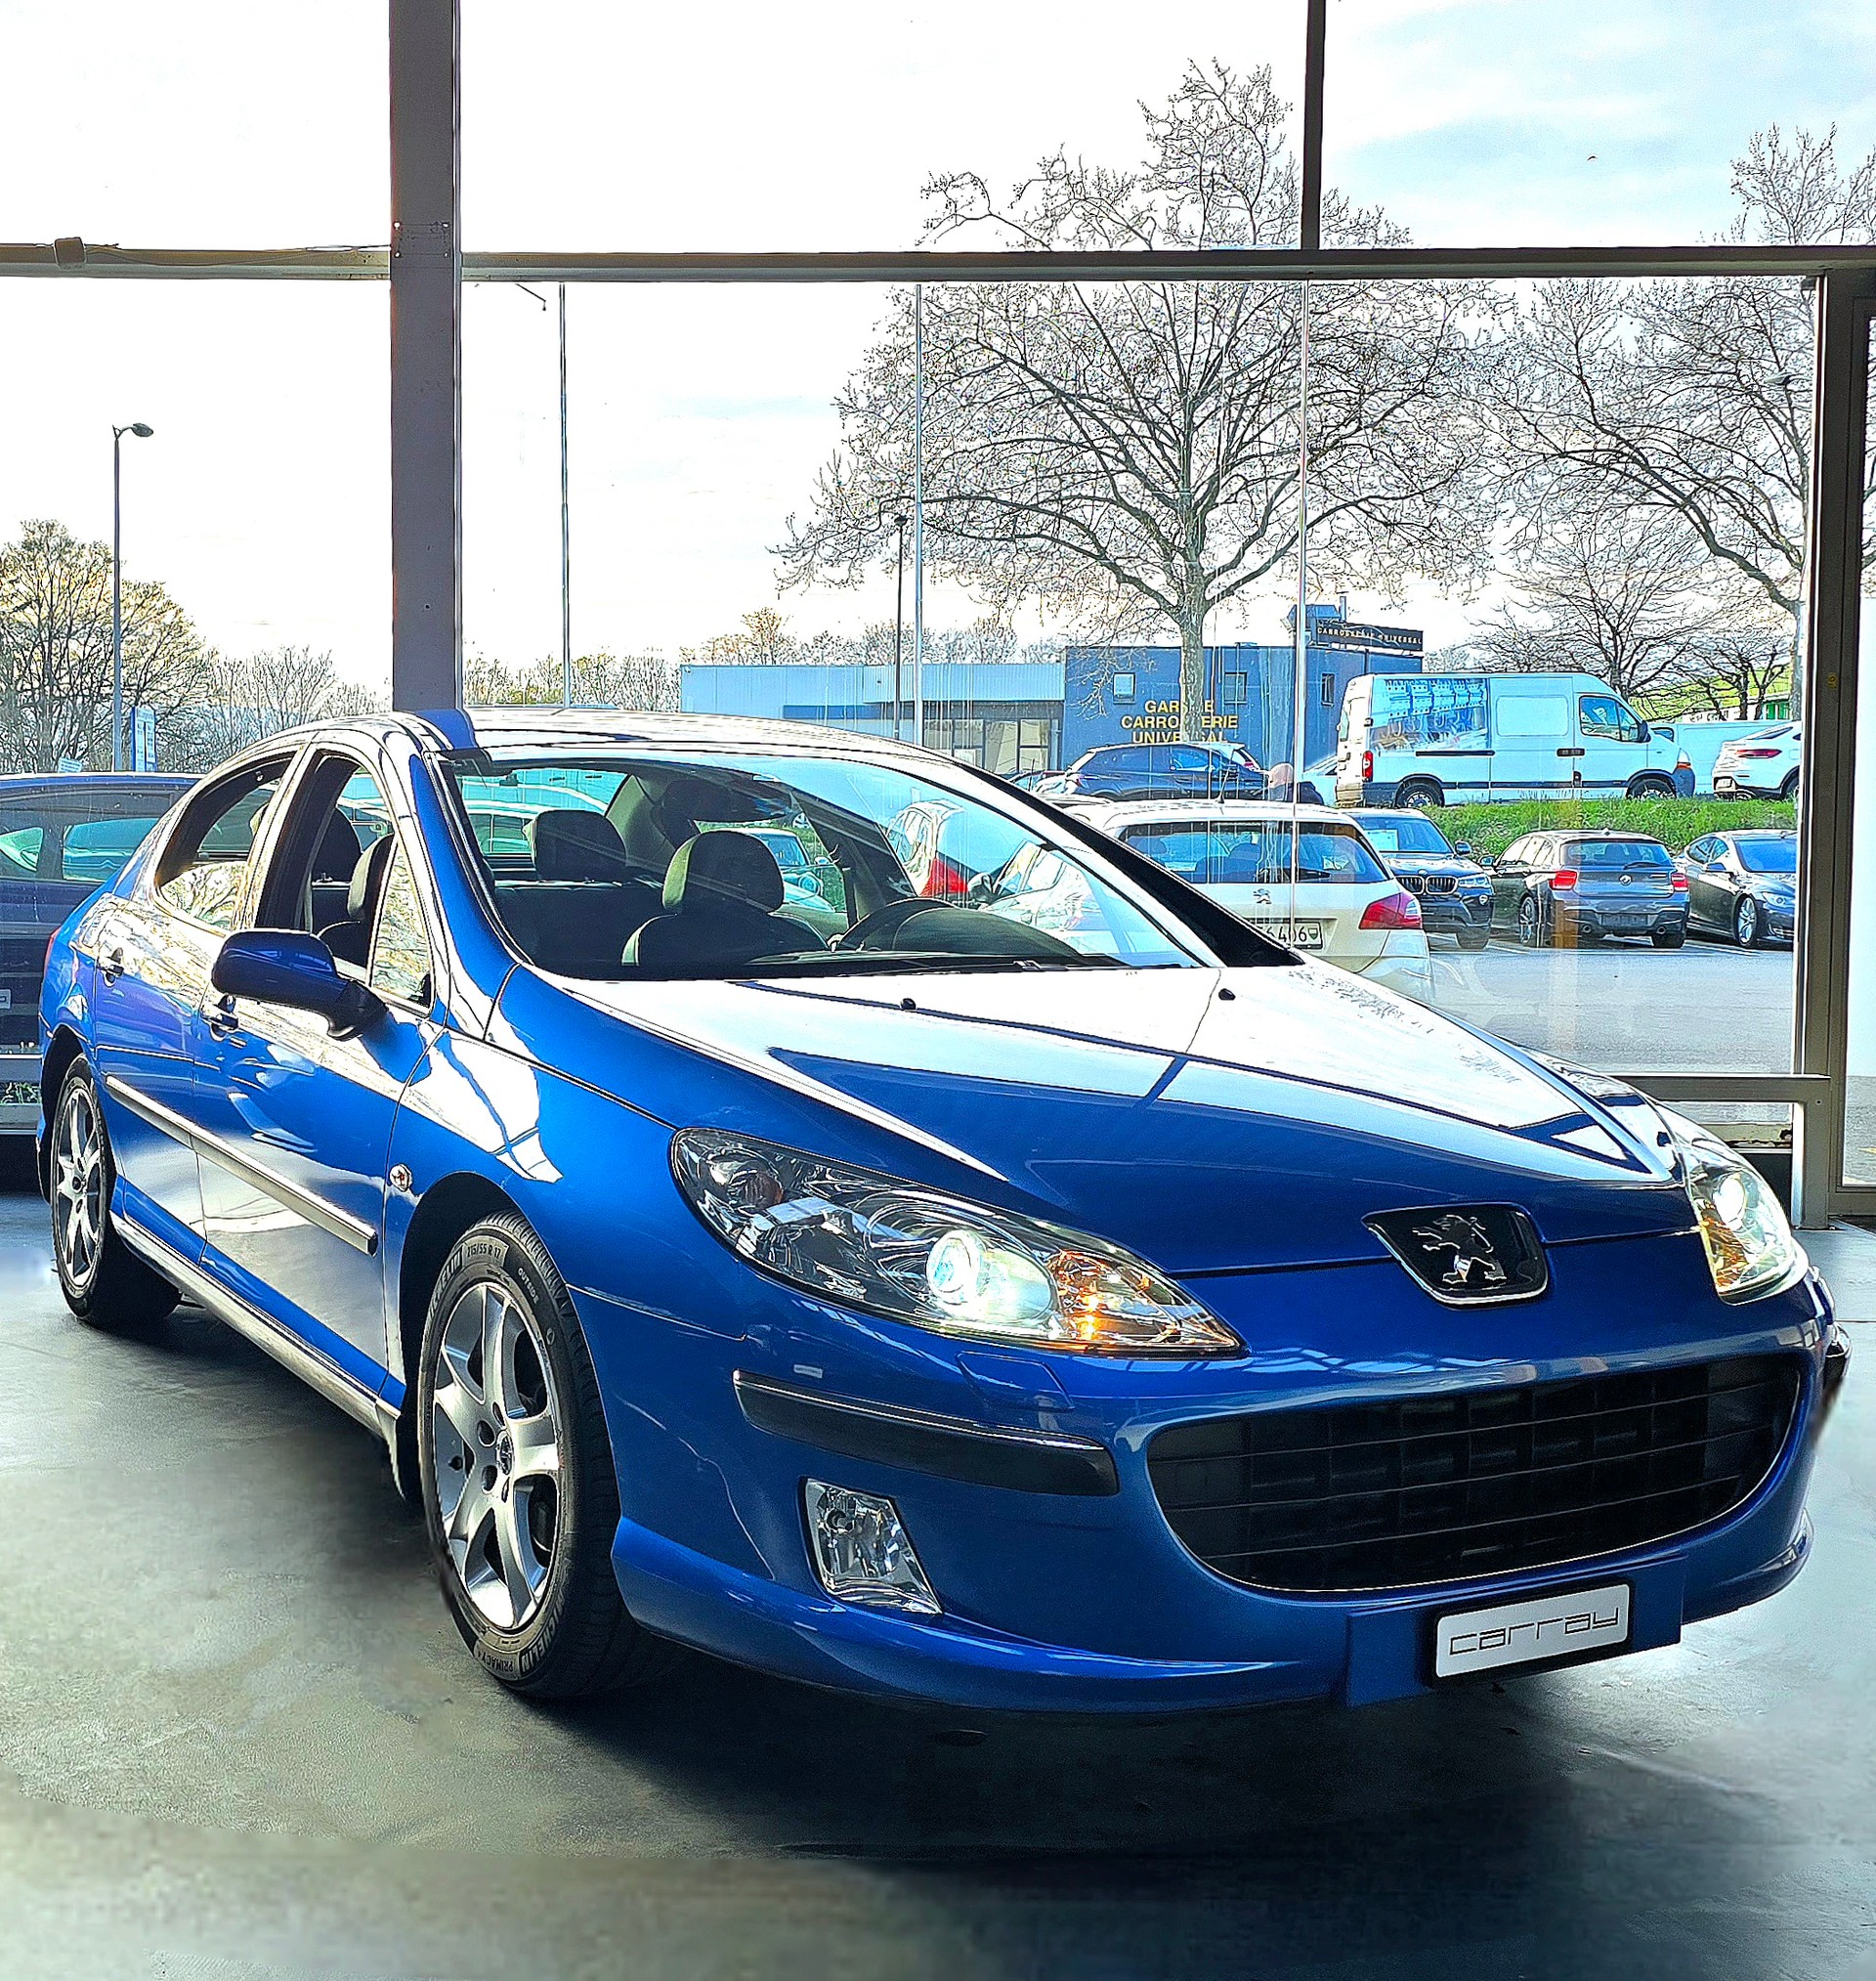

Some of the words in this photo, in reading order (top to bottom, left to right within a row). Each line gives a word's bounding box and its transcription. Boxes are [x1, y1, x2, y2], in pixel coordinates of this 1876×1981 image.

[1144, 700, 1215, 713] GARE
[1121, 714, 1239, 729] CARROERIE
[1131, 731, 1228, 744] UNIVEAL
[518, 1267, 540, 1305] OUTSIDE
[1450, 1607, 1619, 1656] carray
